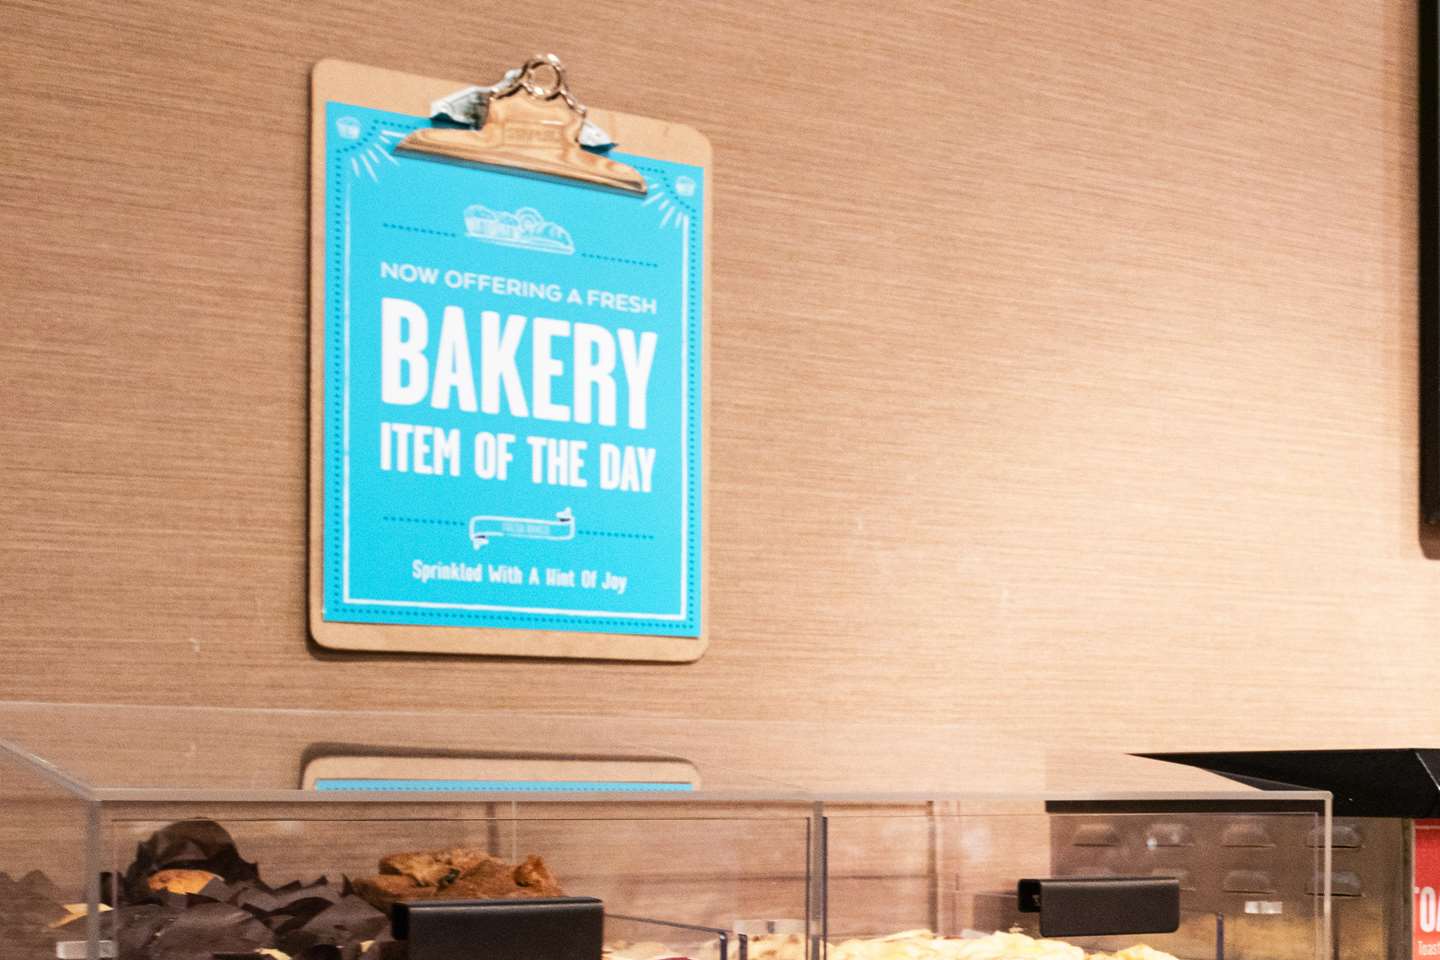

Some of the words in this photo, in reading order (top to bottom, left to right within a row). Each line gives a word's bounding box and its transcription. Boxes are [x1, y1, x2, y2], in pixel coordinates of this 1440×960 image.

[380, 262, 439, 285] NOW
[445, 270, 563, 301] OFFERING
[567, 288, 583, 305] A
[587, 289, 657, 315] FRESH
[381, 297, 658, 430] BAKERY
[380, 422, 461, 477] ITEM
[474, 431, 516, 481] OF
[526, 436, 588, 488] THE
[599, 443, 657, 493] DAY
[412, 559, 483, 583] Sprinkled
[488, 564, 523, 585] With
[528, 567, 540, 585] A
[545, 568, 576, 588] Hint
[602, 572, 628, 595] Joy
